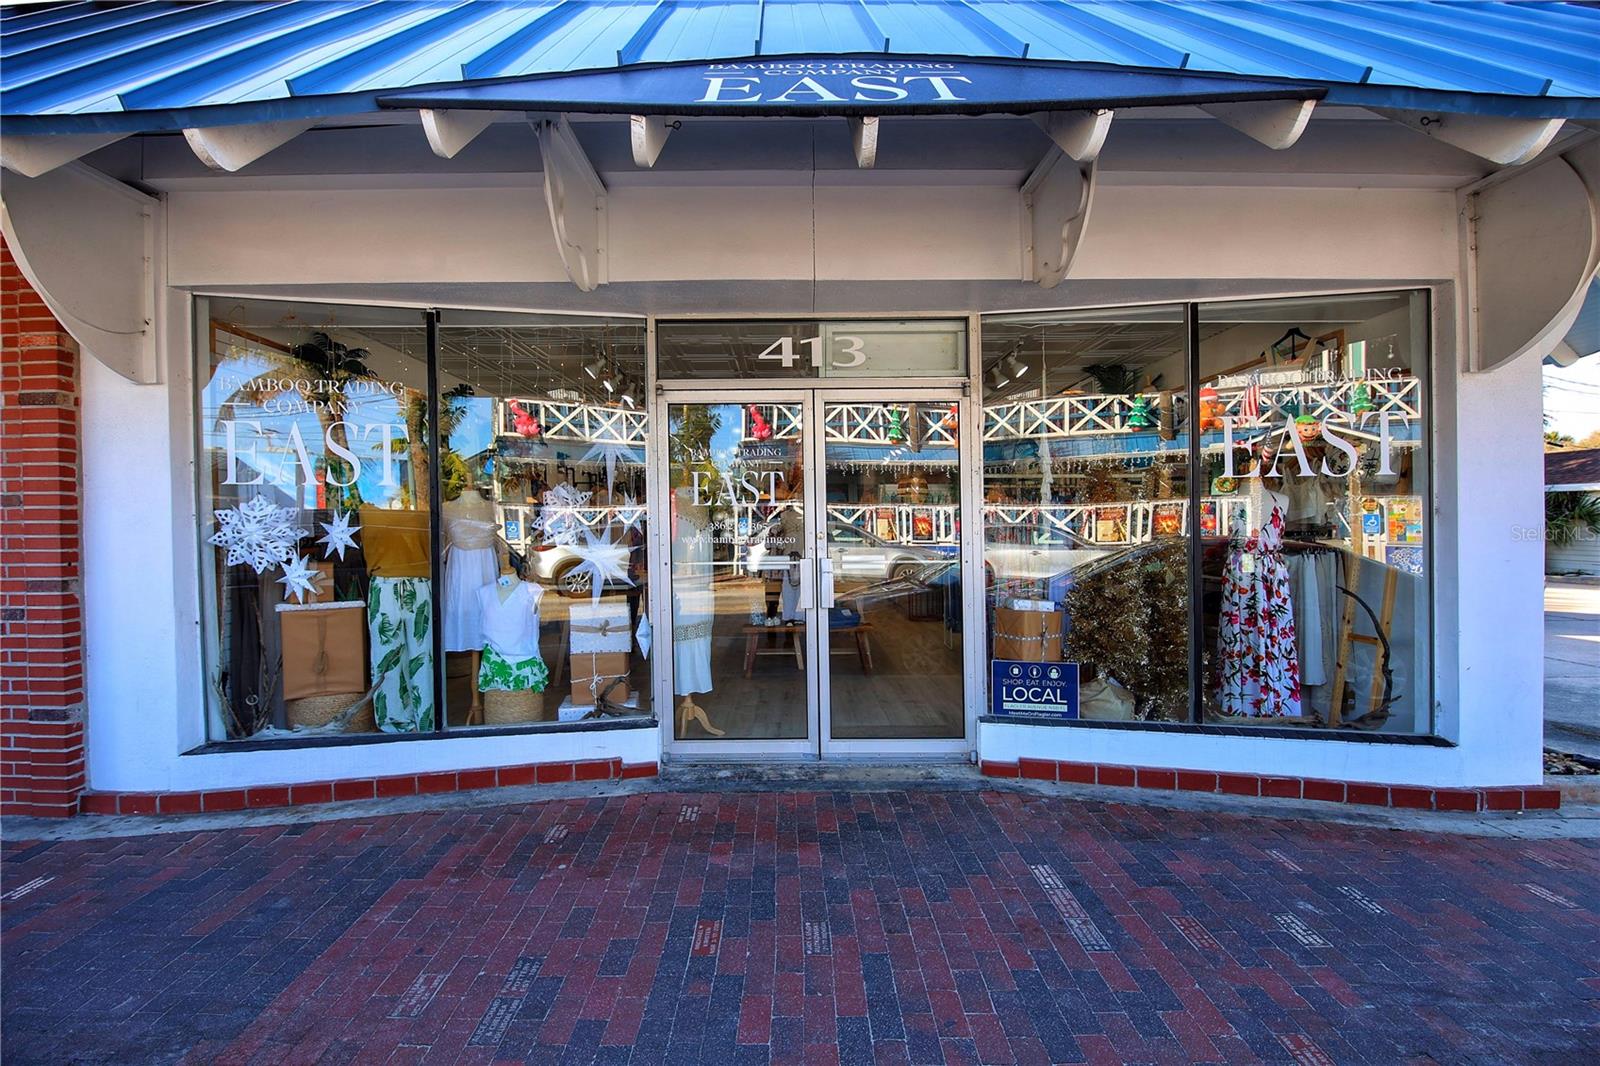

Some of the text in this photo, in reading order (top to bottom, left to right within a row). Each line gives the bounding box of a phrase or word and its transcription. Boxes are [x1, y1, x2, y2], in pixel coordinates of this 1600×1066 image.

[695, 76, 972, 102] EAST
[758, 336, 866, 368] 413
[219, 377, 405, 396] BAMBOO TRADING
[263, 400, 361, 415] COMPANY
[221, 420, 410, 486] EAST
[738, 447, 782, 457] TRADING
[1218, 411, 1410, 478] EAST
[691, 471, 785, 507] EAST
[1003, 686, 1068, 703] LOCAL
